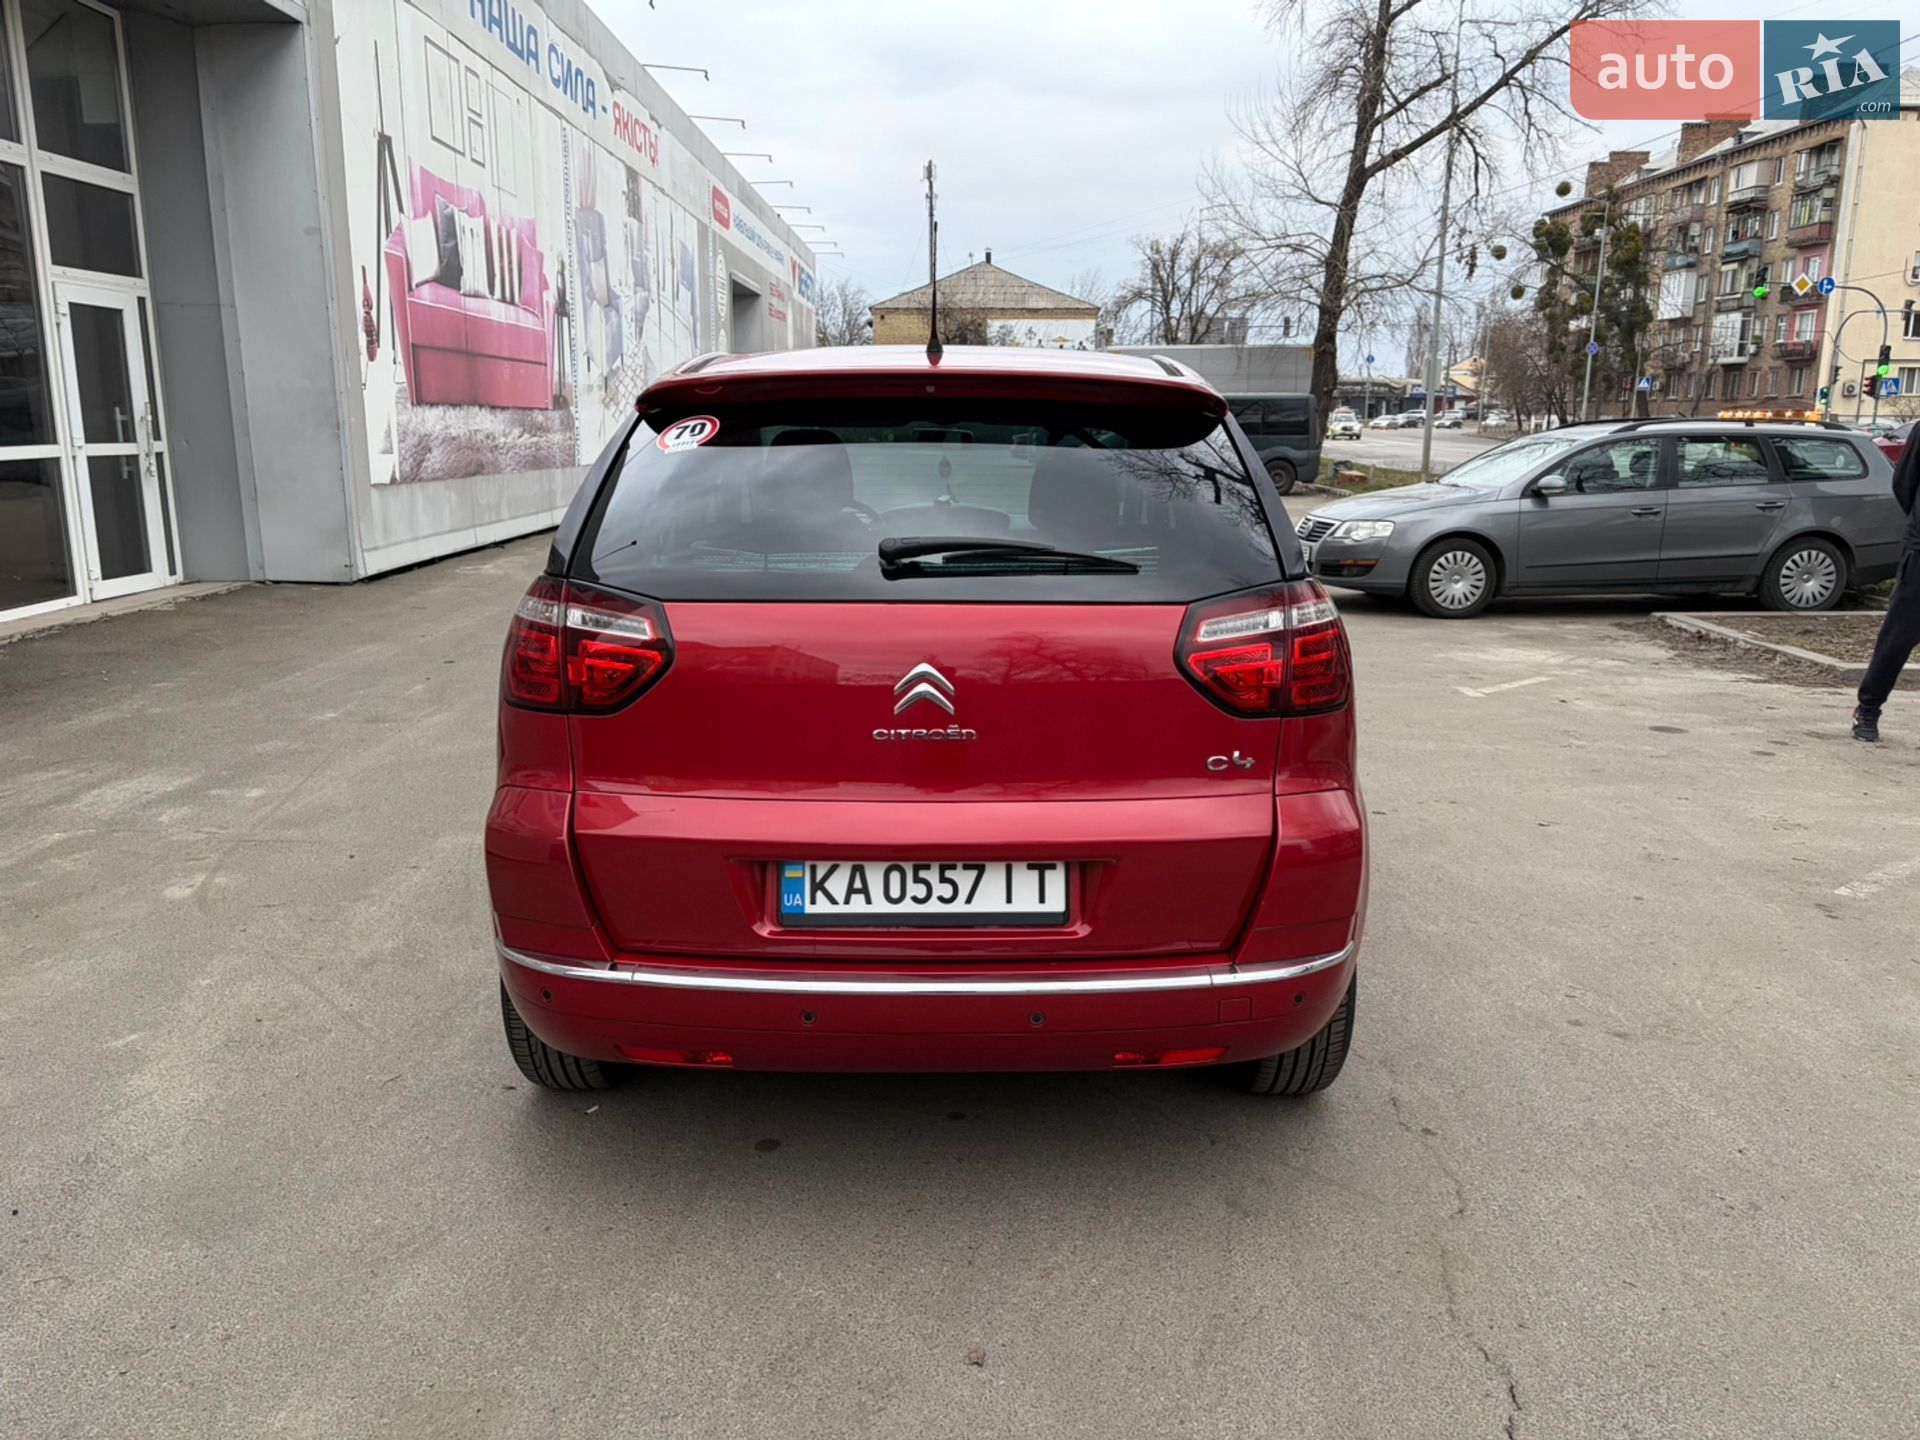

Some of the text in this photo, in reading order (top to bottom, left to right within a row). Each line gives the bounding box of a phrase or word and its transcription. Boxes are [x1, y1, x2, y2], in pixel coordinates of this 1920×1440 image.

[548, 43, 597, 120] СИЛА
[612, 100, 660, 168] ЯКІСТЬ!
[674, 422, 707, 440] 70
[1206, 750, 1256, 771] C4
[882, 863, 986, 905] 0557
[783, 893, 803, 907] UA
